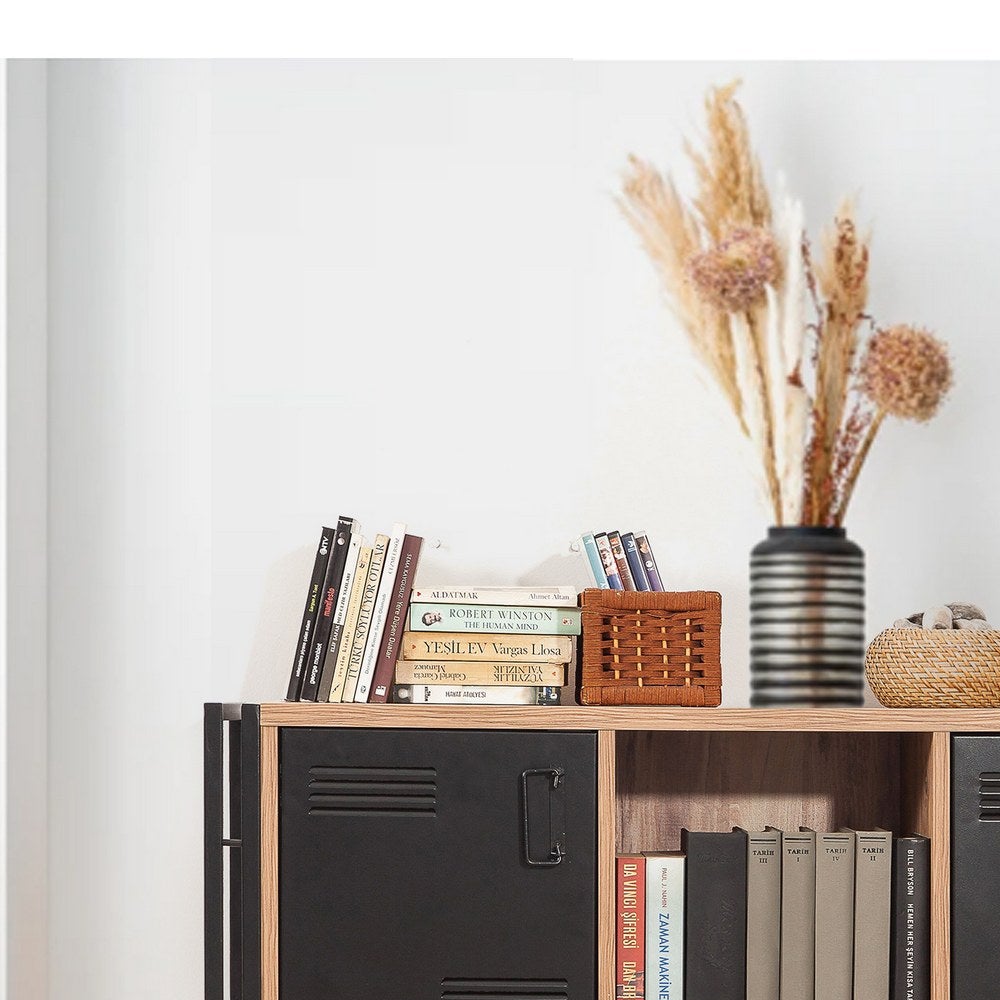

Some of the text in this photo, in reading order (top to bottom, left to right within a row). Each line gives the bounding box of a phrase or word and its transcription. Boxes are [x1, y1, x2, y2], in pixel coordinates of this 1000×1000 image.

[405, 553, 413, 569] SEMA
[323, 587, 335, 617] manifesto
[430, 591, 479, 600] ALDATMAK
[528, 593, 570, 601] Ahmet Altan
[348, 640, 363, 680] TÜRKÜ
[356, 583, 376, 640] SÖYLÜYOR
[370, 543, 385, 582] OTLAR
[449, 608, 552, 621] ROBERT WINSTON
[386, 600, 404, 659] Yere Düşen Dualar
[464, 621, 539, 631] THE HUMAN MIND
[424, 641, 561, 658] YEŞİL EV Vargas Llosa
[310, 642, 322, 685] george monbiot
[494, 665, 543, 674] YALNIZLIK
[439, 672, 467, 681] Gabriel
[494, 673, 543, 683] YÜZYILLIK
[621, 864, 640, 950] DA VINCI ŞİFRESİ
[658, 913, 670, 953] ZAMAN
[906, 947, 915, 969] ŞEYİN
[622, 961, 637, 982] DAN
